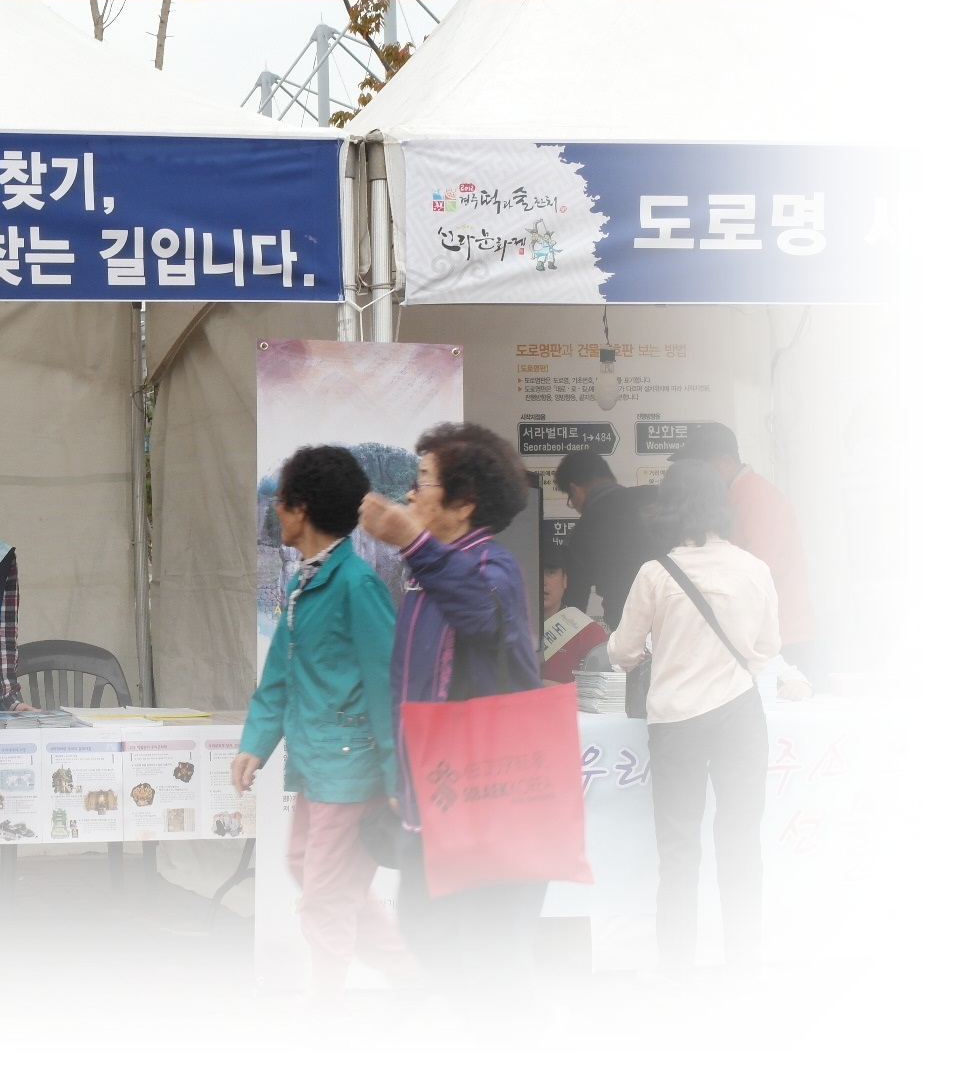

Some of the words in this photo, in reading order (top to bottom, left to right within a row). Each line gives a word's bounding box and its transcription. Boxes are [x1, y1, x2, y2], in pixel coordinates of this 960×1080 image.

[633, 191, 827, 257] 도로명
[99, 226, 315, 288] 길입니다.
[515, 343, 574, 358] 도로명판과
[577, 343, 634, 358] 건물호판
[638, 343, 661, 358] 보는
[664, 343, 687, 358] 방법
[522, 426, 579, 440] 서라벌대로
[647, 425, 689, 439] 원화로
